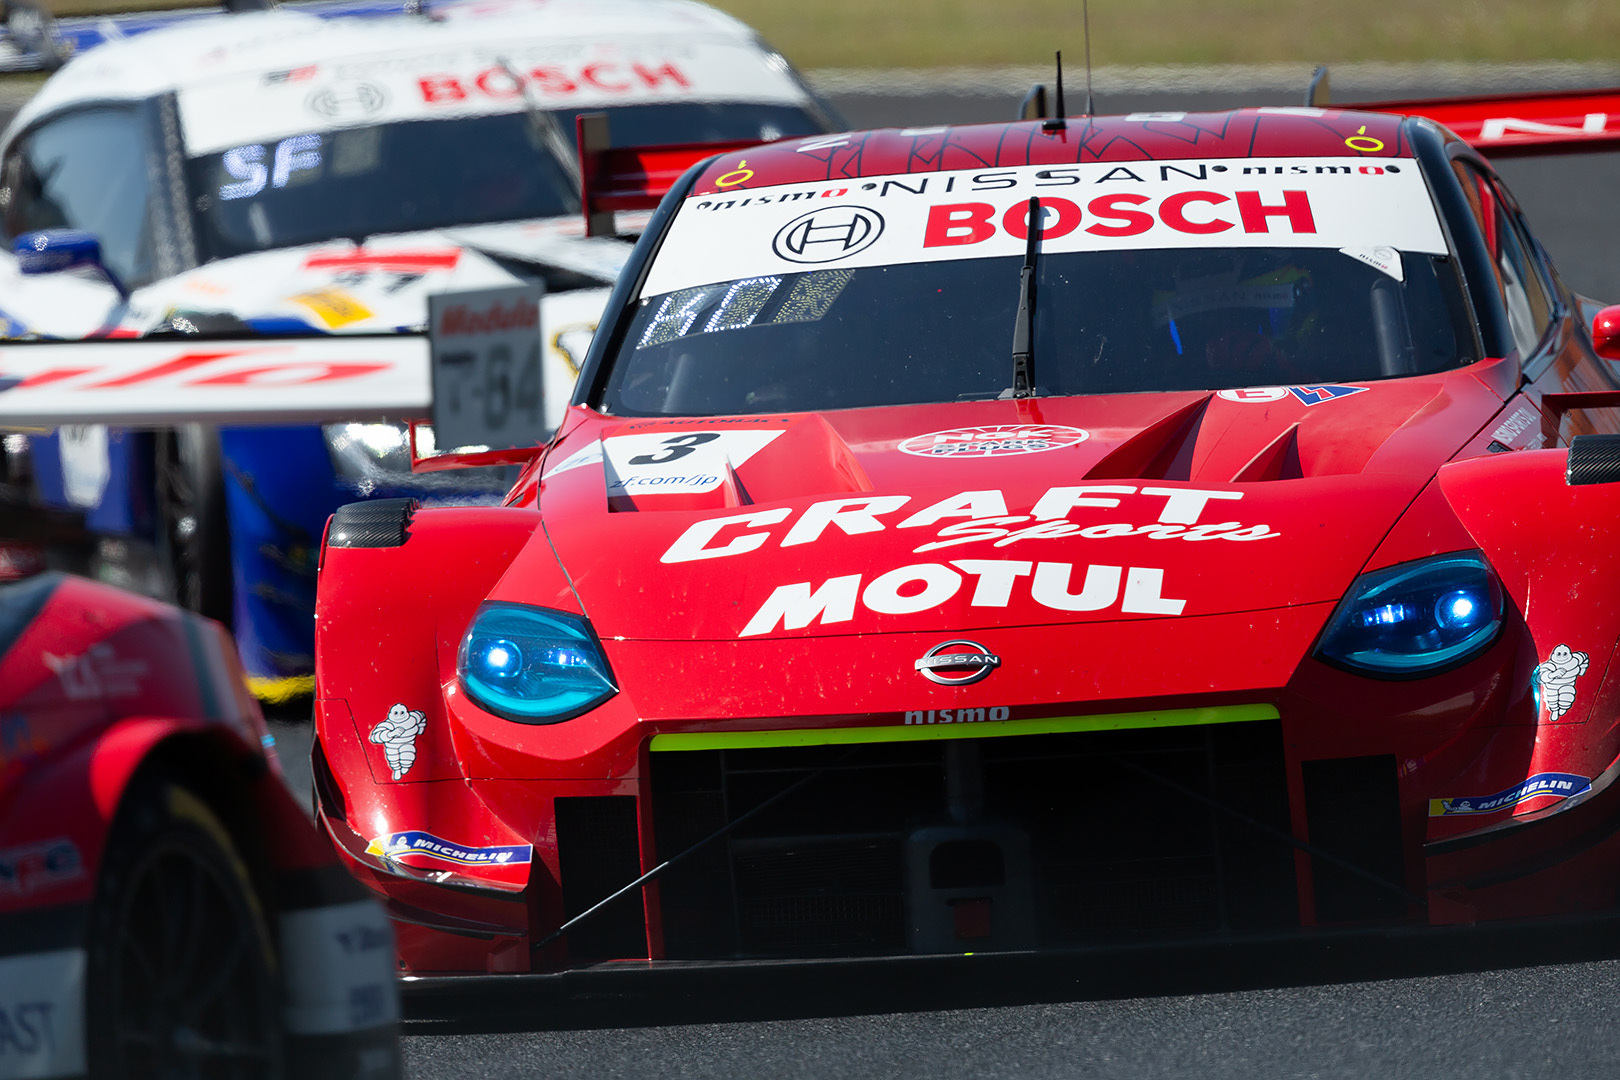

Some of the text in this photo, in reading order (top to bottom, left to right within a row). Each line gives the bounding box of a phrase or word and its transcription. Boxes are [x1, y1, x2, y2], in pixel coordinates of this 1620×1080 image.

[417, 60, 692, 105] BOSCH
[219, 132, 323, 201] SF
[712, 163, 1385, 211] nismo NISSAN nismo
[923, 189, 1318, 249] BOSCH
[628, 432, 721, 465] 3
[609, 473, 718, 489] zf.com/jp
[659, 484, 1243, 564] CRAFT
[911, 514, 1282, 553] Sports
[739, 560, 1187, 637] MOTUL
[917, 655, 998, 667] NISSAN
[905, 706, 1010, 725] nismo
[1478, 780, 1573, 810] MICHELIN
[413, 838, 514, 863] MICHELIN
